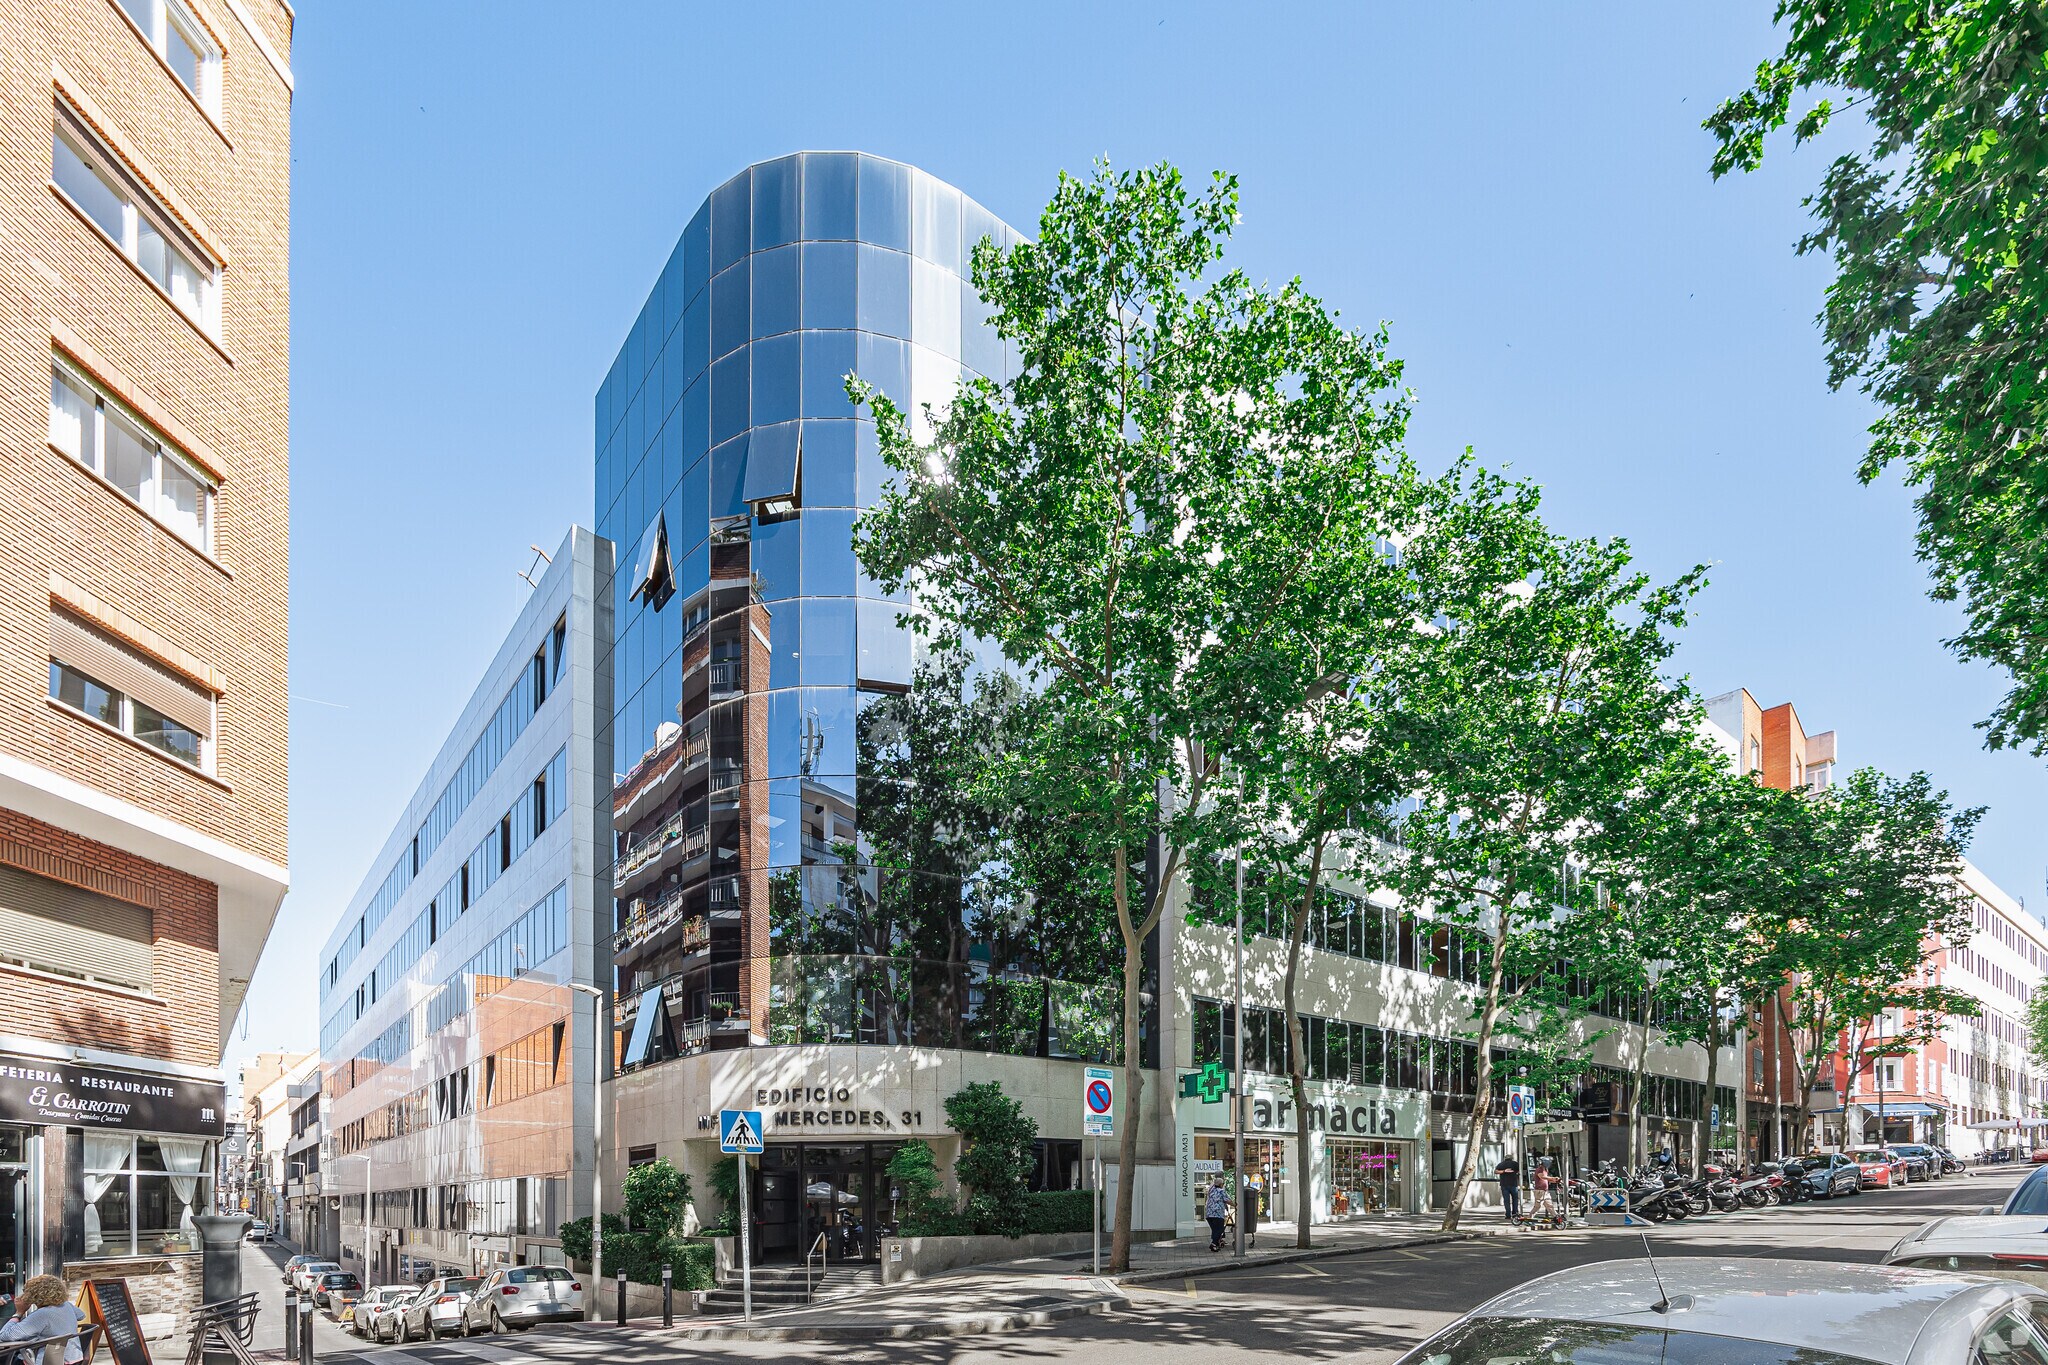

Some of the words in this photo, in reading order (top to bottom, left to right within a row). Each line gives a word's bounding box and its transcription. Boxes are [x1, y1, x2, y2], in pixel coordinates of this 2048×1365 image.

[81, 1076, 174, 1097] RESTAURANTE
[757, 1087, 850, 1105] EDIFICIO
[28, 1086, 50, 1107] EL
[53, 1092, 131, 1115] GARROTIN
[775, 1110, 891, 1127] MERCEDES,
[902, 1111, 922, 1126] 31
[1253, 1099, 1396, 1135] armacia
[1194, 1161, 1220, 1171] AUDALÍE
